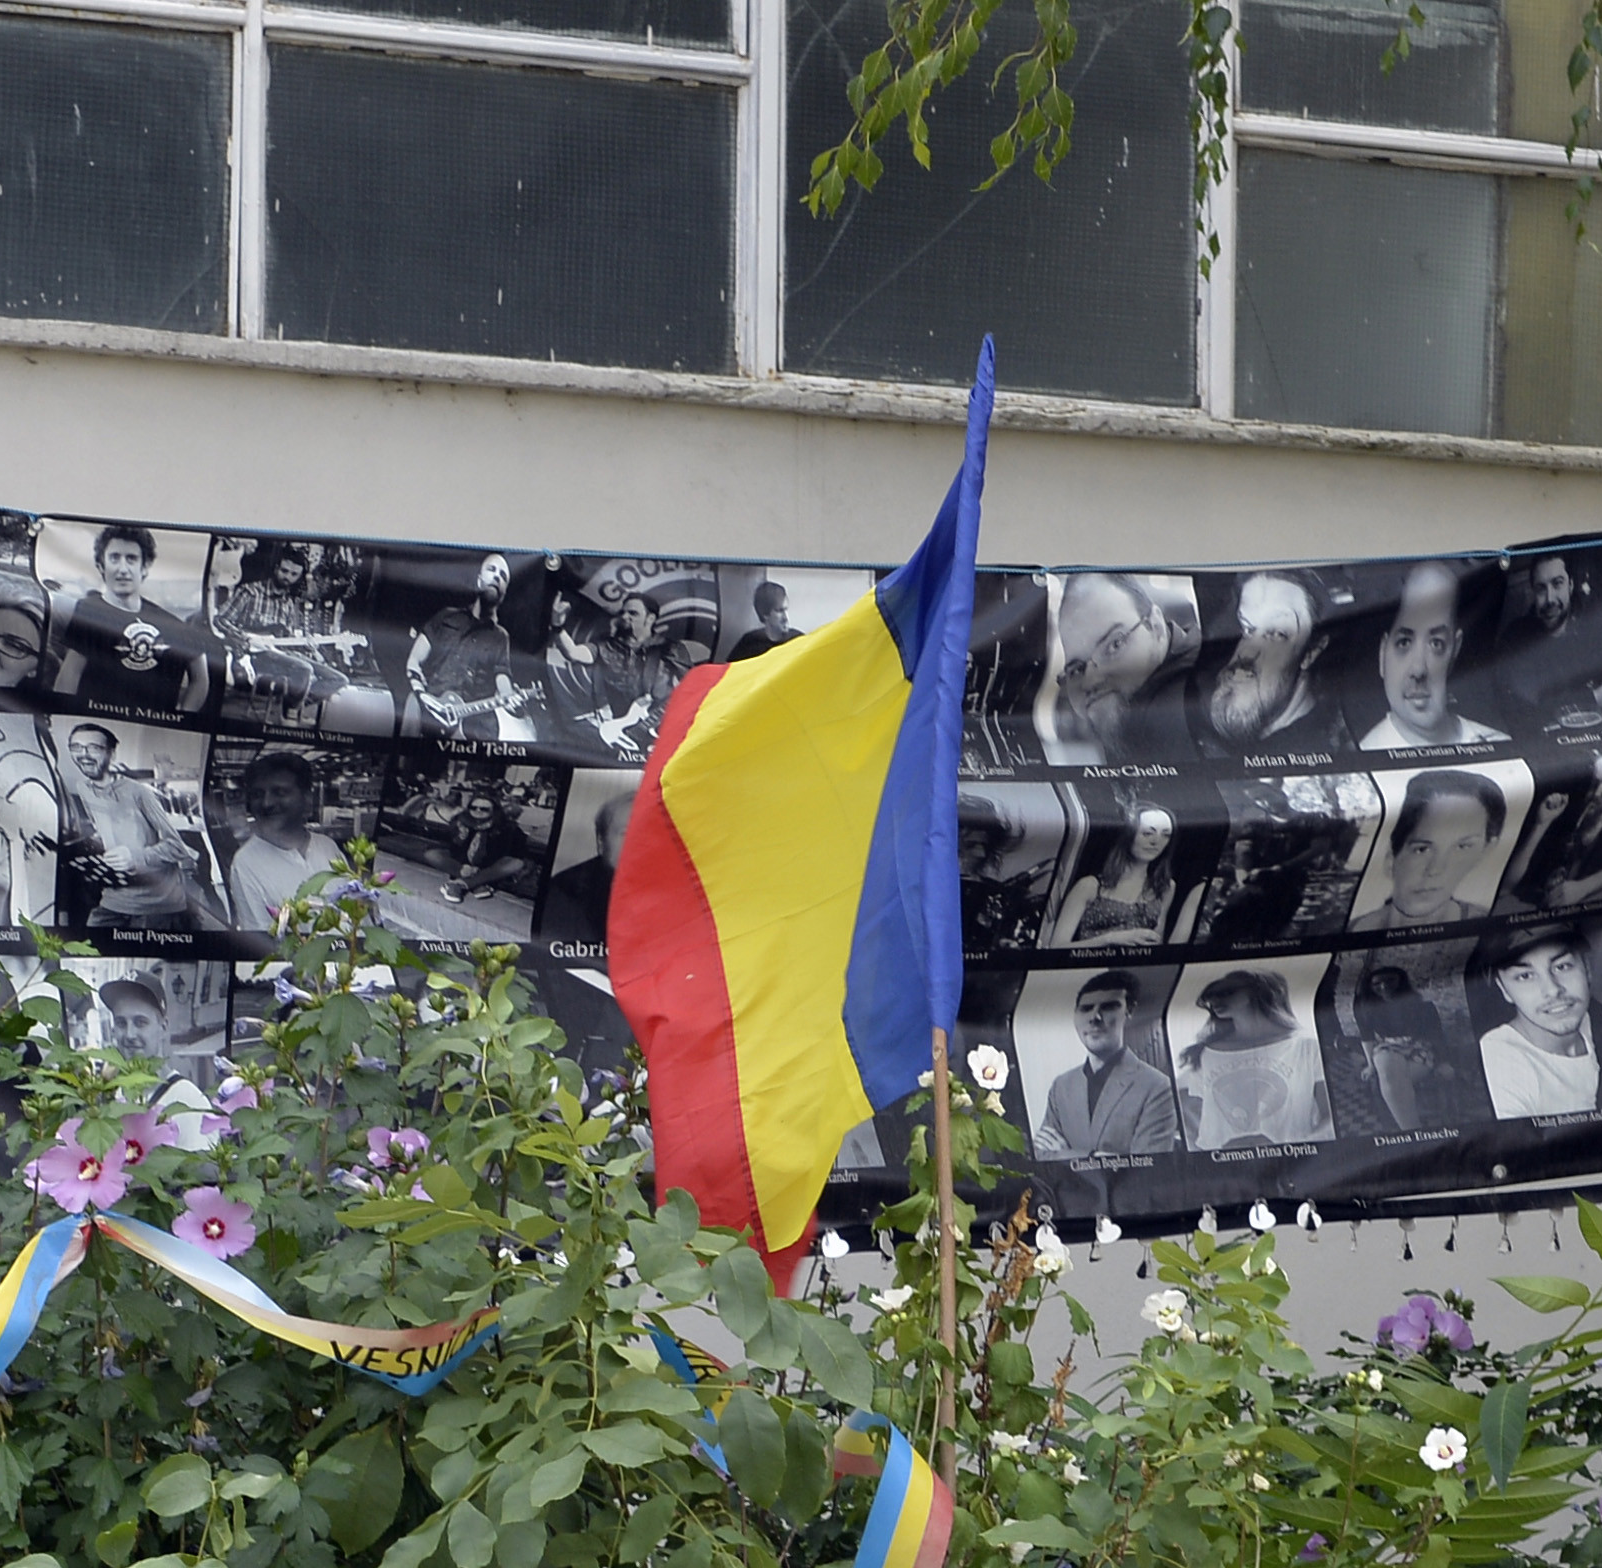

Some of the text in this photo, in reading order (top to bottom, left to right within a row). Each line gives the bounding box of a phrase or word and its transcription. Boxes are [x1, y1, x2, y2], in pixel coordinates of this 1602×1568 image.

[88, 699, 184, 723] Ionuț Maior
[1557, 732, 1599, 746] Claudiu
[436, 740, 477, 756] Vlad
[1387, 743, 1495, 760] Florin Cristian Popescu
[617, 750, 647, 763] Alex
[1243, 754, 1287, 768] Adrian
[1082, 764, 1178, 778] Alex Chelba
[146, 930, 193, 945] Popescu
[419, 940, 453, 953] Anda
[1069, 948, 1116, 959] Mihaela
[1373, 1127, 1460, 1147] Diana Enache
[1211, 1149, 1253, 1163] Carmen
[1255, 1146, 1282, 1160] Irina
